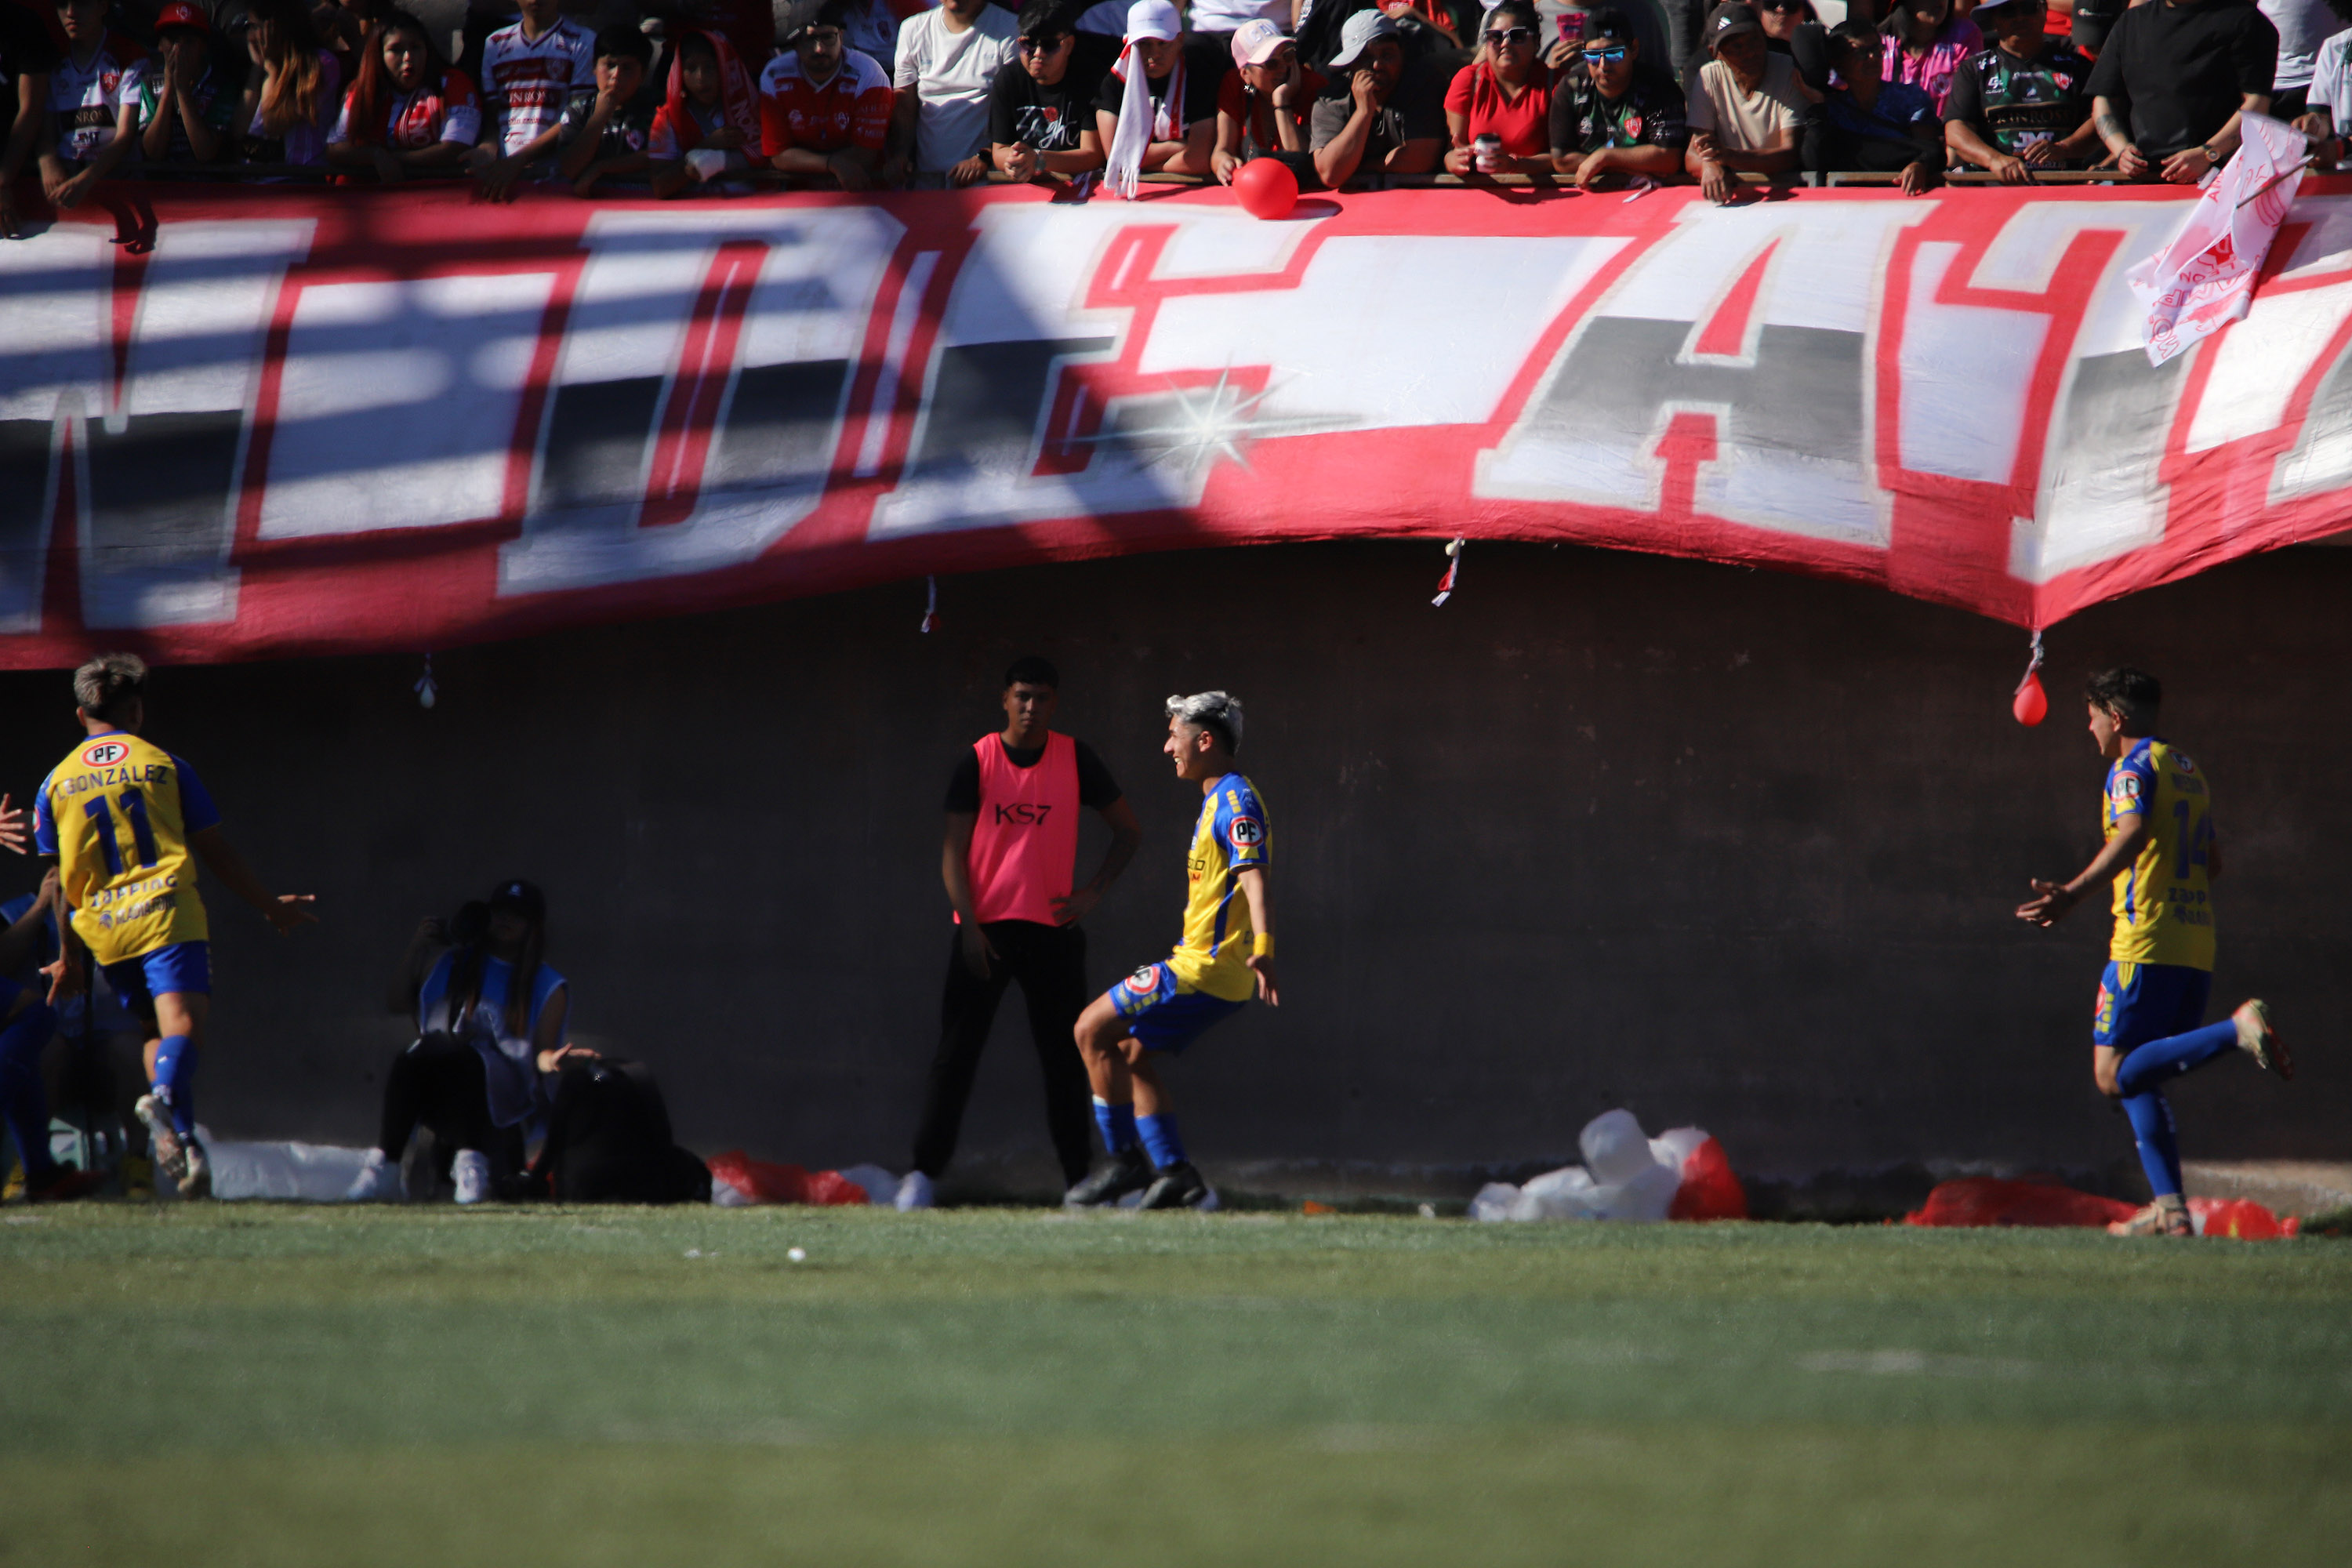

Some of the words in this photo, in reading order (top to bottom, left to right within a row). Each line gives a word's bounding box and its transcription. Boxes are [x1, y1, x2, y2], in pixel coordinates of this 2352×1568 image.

[93, 746, 117, 762] PF
[994, 803, 1051, 826] KS7
[83, 788, 158, 877] 11
[1236, 822, 1258, 842] PF
